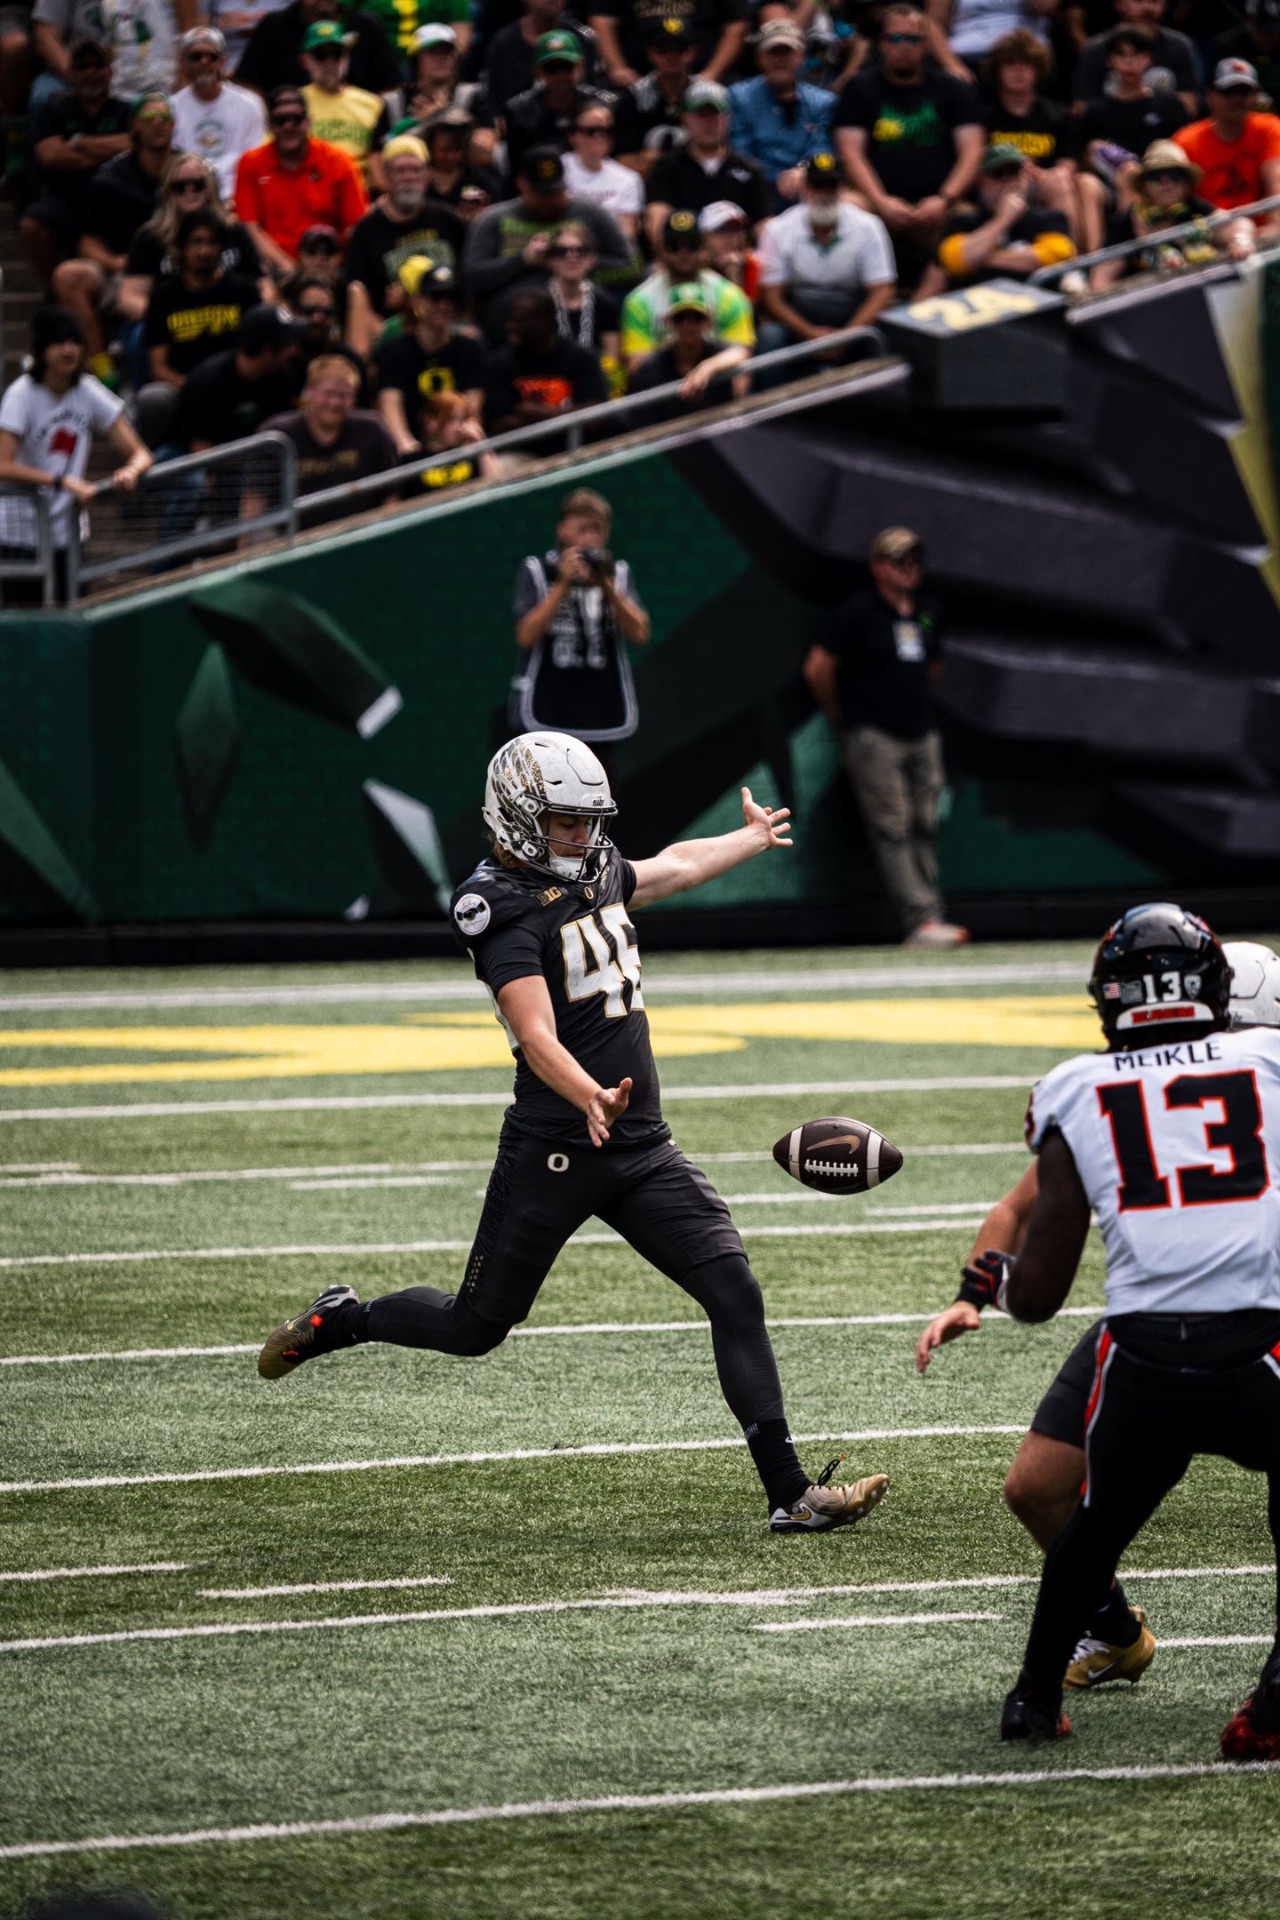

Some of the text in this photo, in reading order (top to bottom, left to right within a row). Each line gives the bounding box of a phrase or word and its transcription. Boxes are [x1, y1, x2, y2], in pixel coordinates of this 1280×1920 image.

[1143, 971, 1182, 1004] 13
[1114, 1040, 1222, 1071] MEIKLE
[1096, 1069, 1271, 1212] 13
